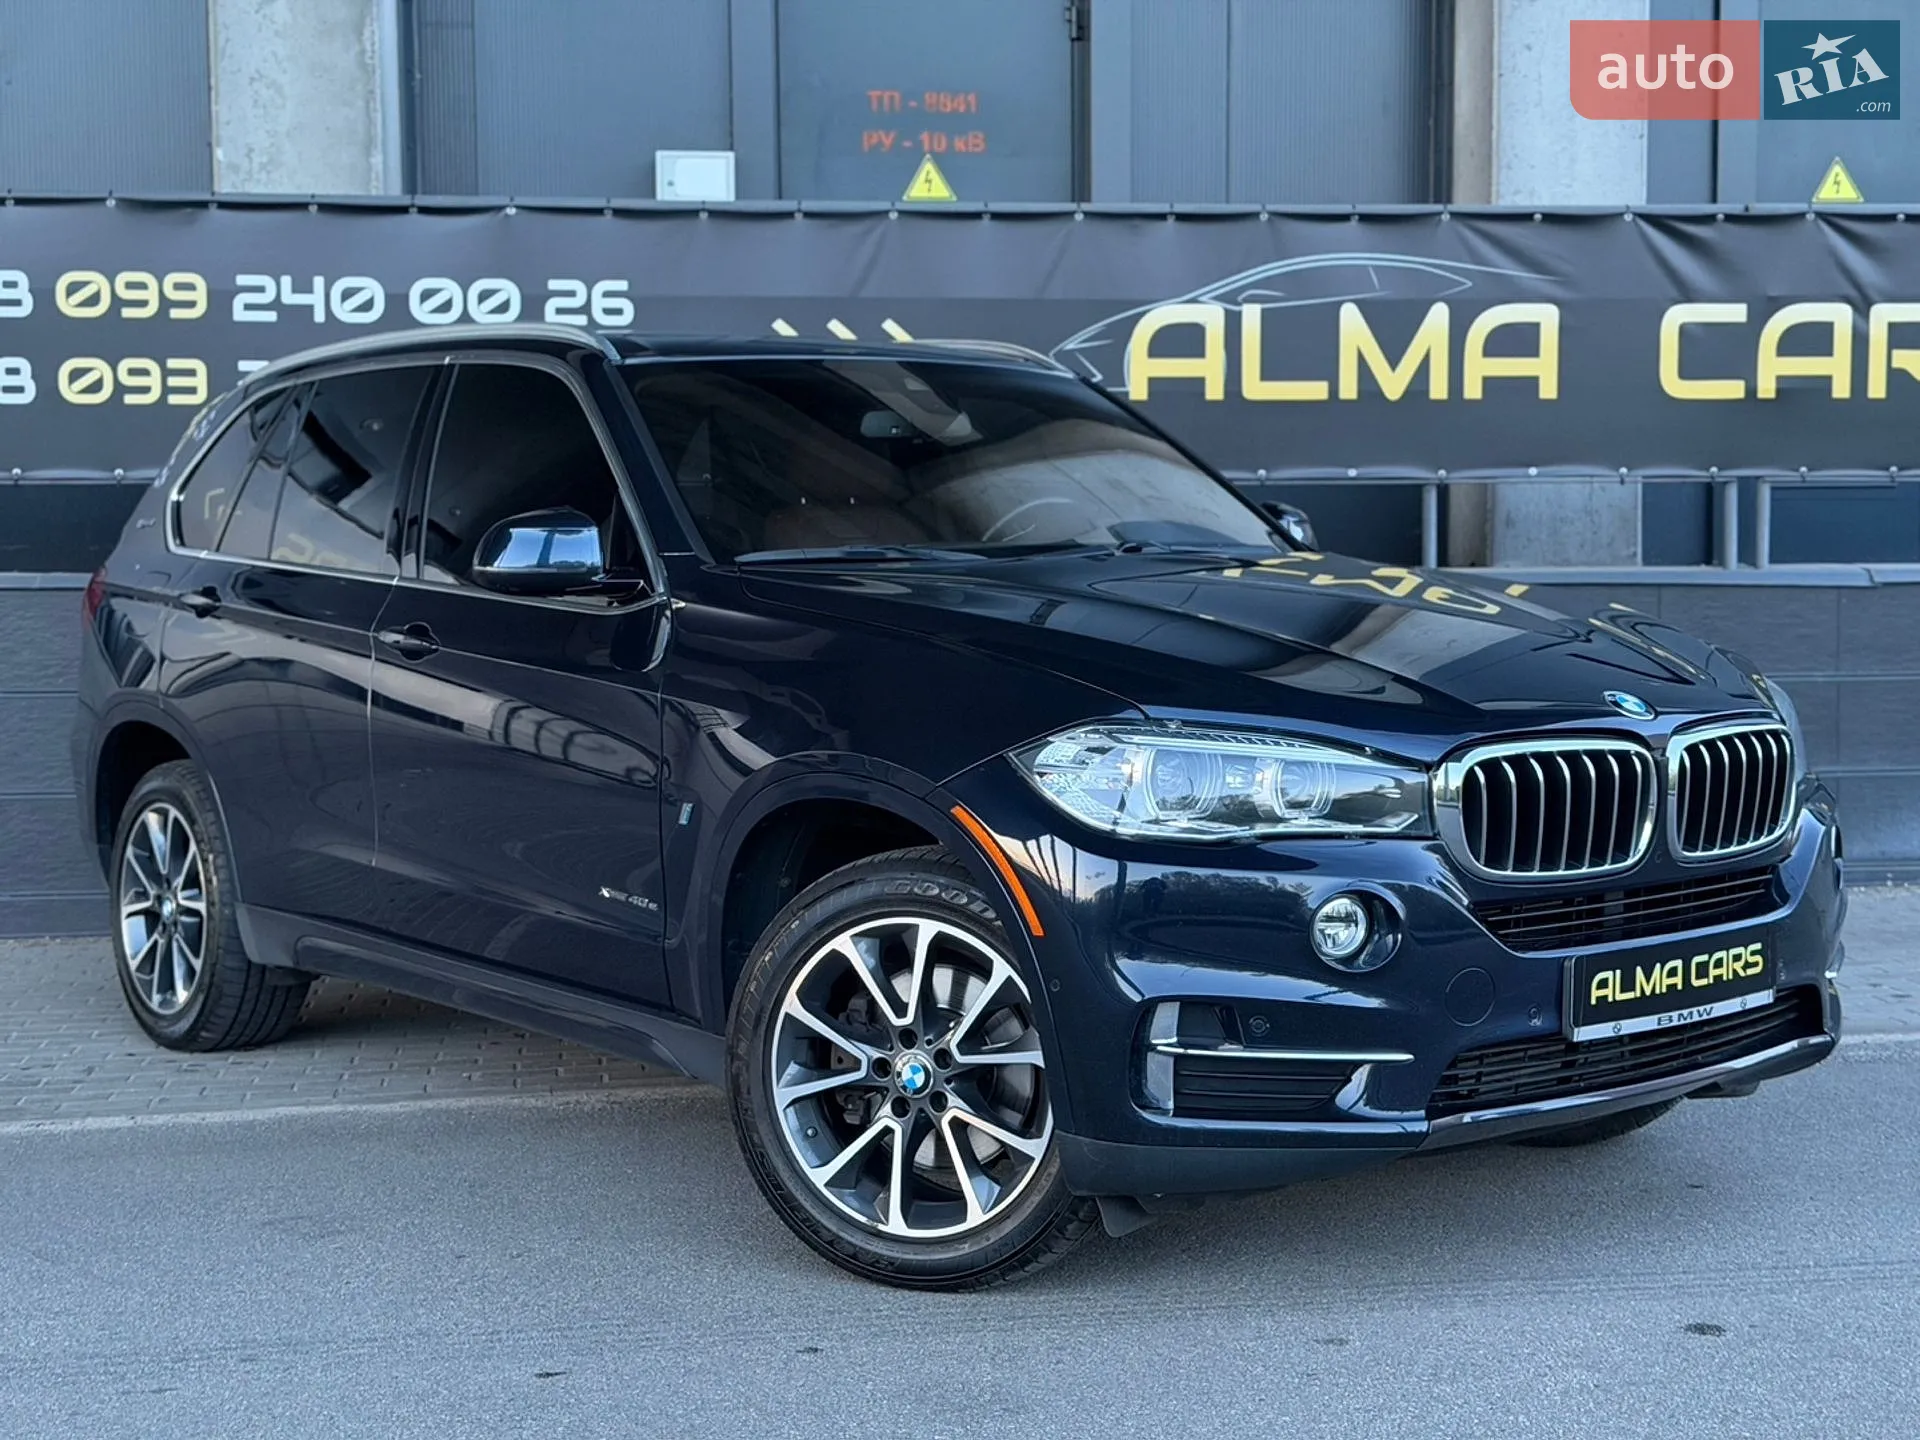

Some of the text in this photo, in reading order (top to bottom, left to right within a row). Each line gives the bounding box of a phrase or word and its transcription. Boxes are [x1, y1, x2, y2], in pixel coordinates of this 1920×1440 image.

[920, 130, 948, 153] 10
[55, 270, 208, 319] 099
[232, 274, 386, 323] 240
[409, 277, 521, 325] 00
[544, 279, 635, 326] 26
[1128, 301, 1561, 401] ALMA
[57, 356, 209, 406] 093
[1590, 942, 1765, 1006] ALMA CARS
[1656, 1005, 1716, 1028] BMW
